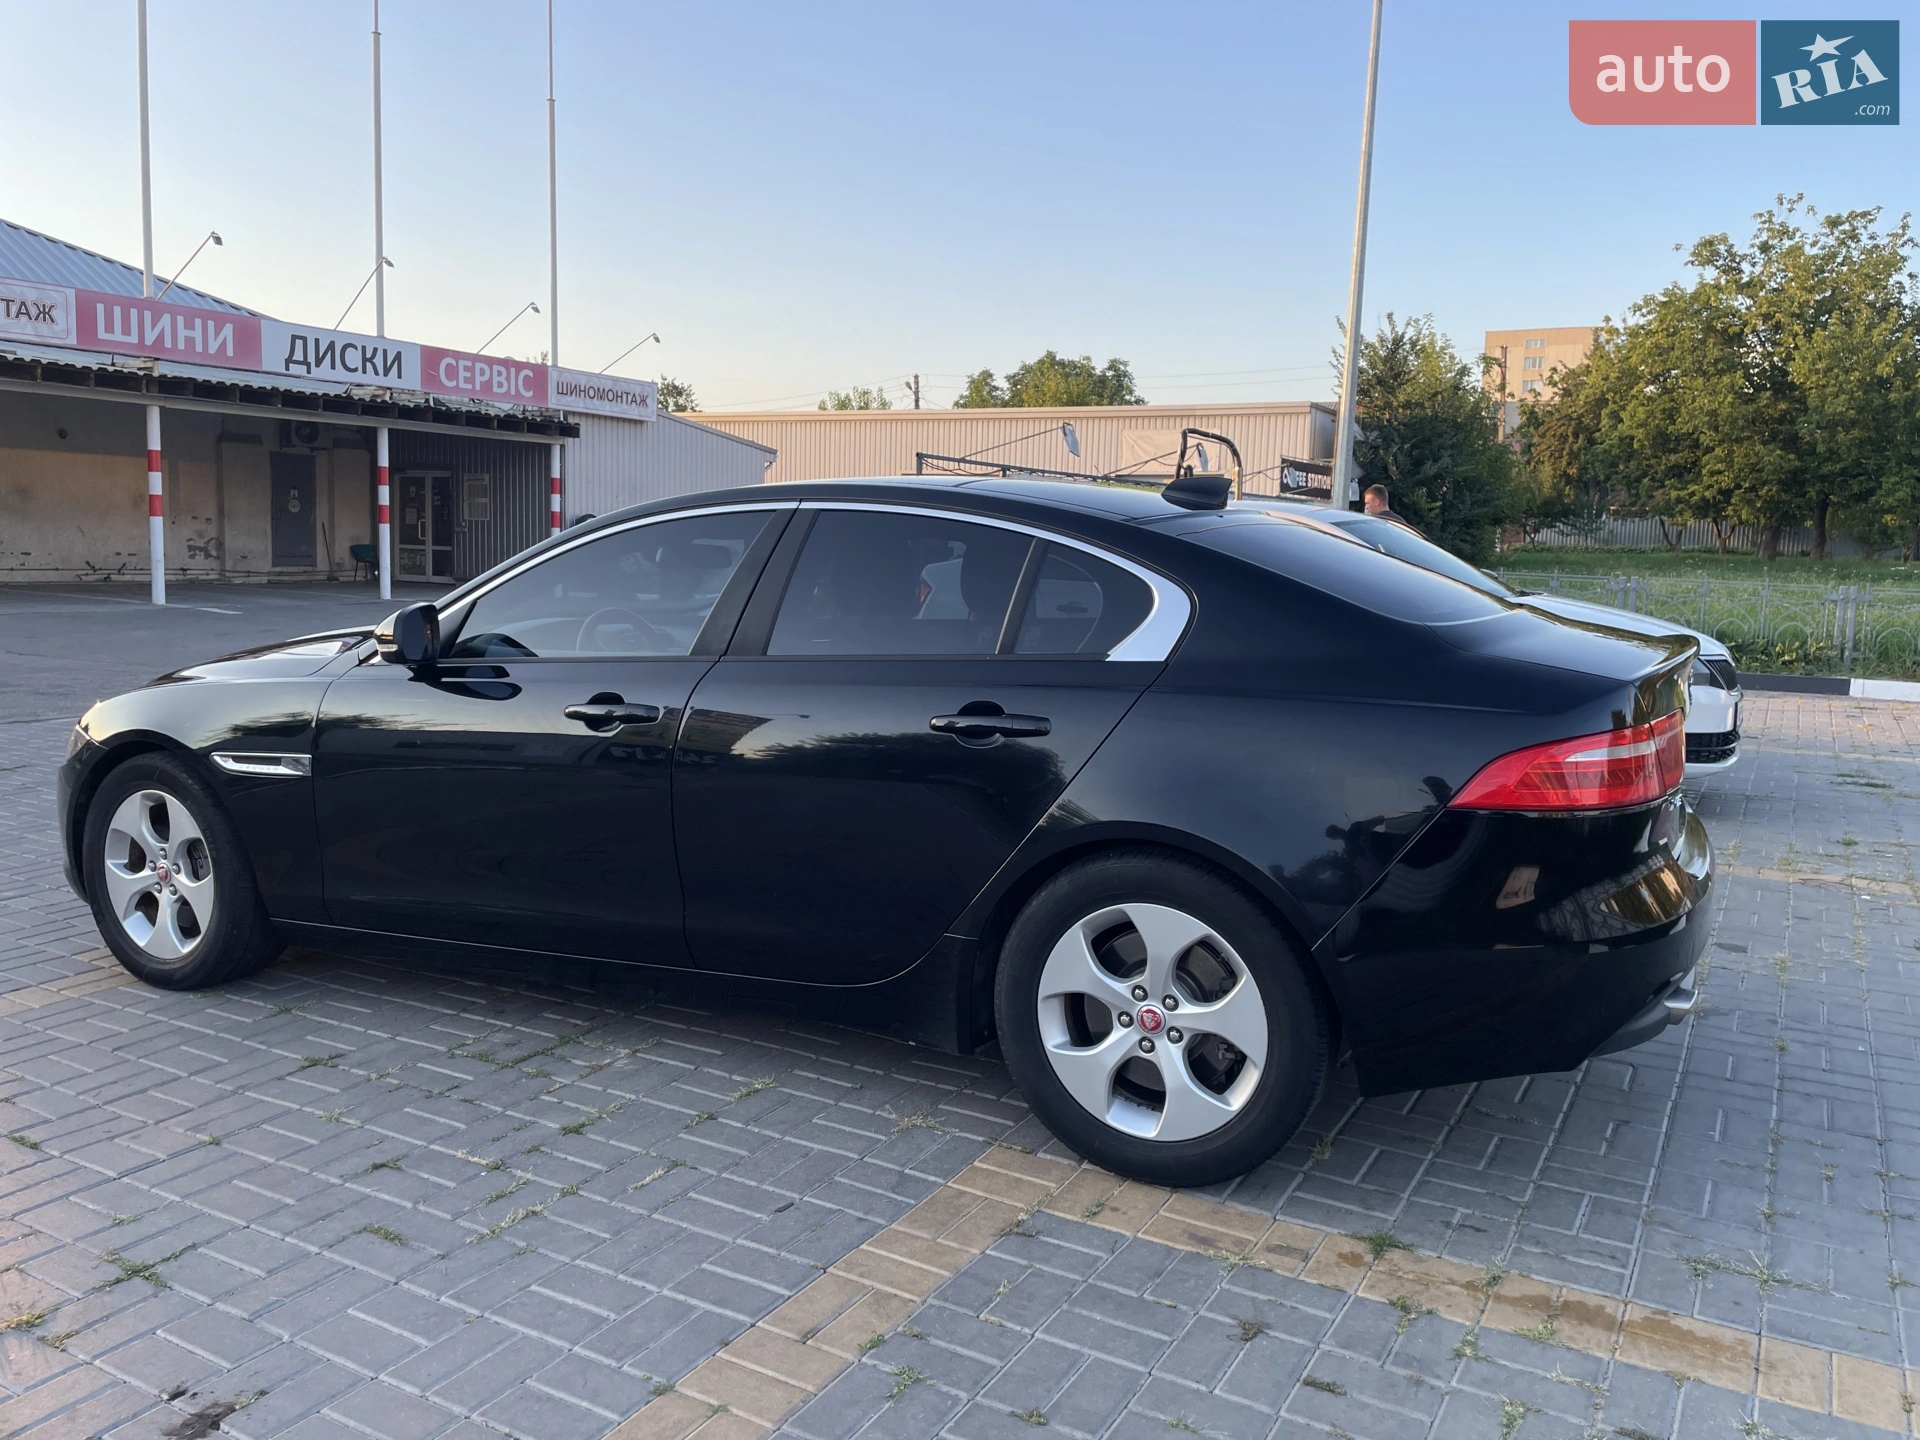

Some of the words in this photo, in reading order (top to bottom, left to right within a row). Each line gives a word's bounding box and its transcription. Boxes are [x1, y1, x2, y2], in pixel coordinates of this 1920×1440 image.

[96, 302, 234, 357] ШИНИ
[284, 333, 403, 380] ДИСКИ
[439, 357, 534, 398] СЕРВІС
[556, 381, 649, 408] ШИНОМОНТАЖ
[1307, 472, 1332, 490] STATION
